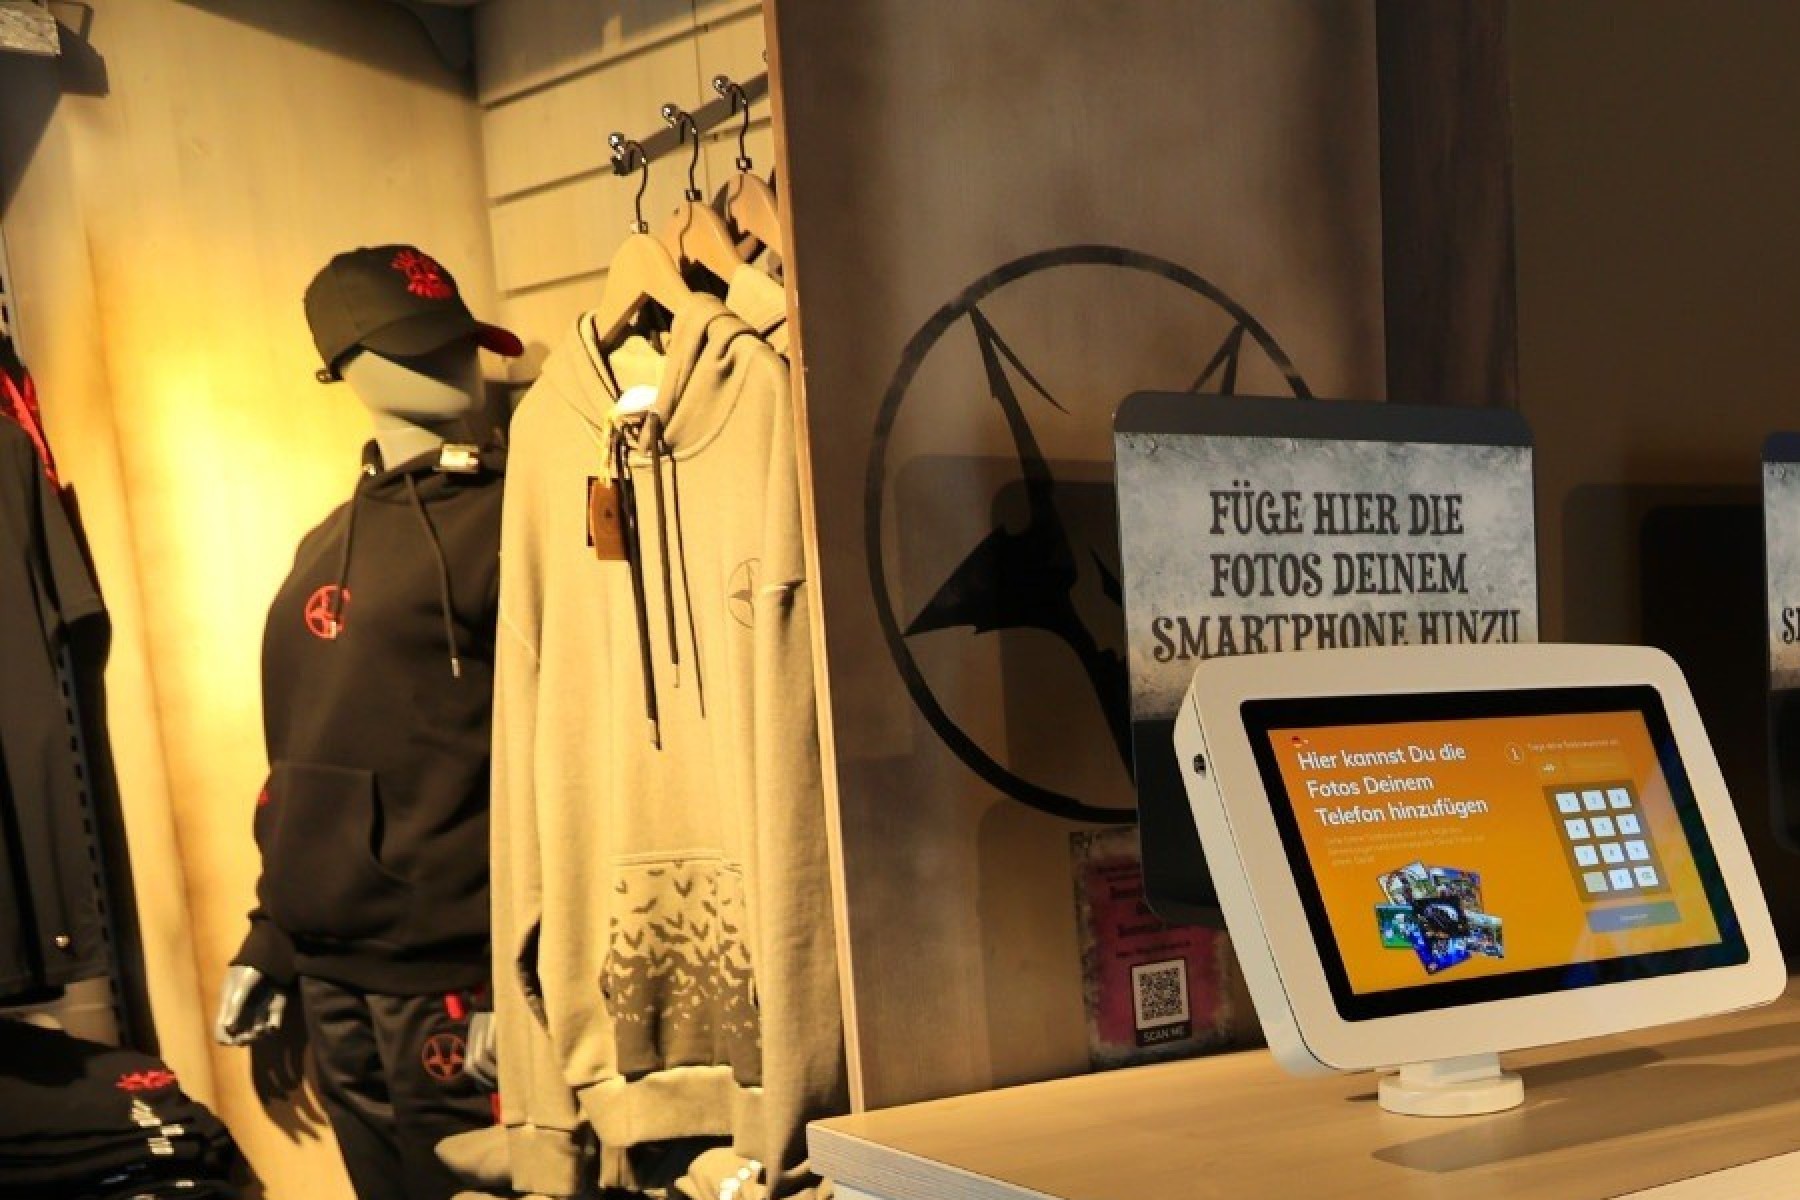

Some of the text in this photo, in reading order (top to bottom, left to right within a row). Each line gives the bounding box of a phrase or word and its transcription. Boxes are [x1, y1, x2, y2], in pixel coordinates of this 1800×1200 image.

[1209, 480, 1464, 535] FÜGE HIER DIE
[1210, 552, 1469, 597] FOTOS DEINEM
[1151, 609, 1521, 662] SMARTPHONE HINZU
[1298, 743, 1466, 770] Hier kannst Du die
[1306, 775, 1434, 798] Fotos Deinem
[1314, 798, 1489, 826] Telefon hinzufügen
